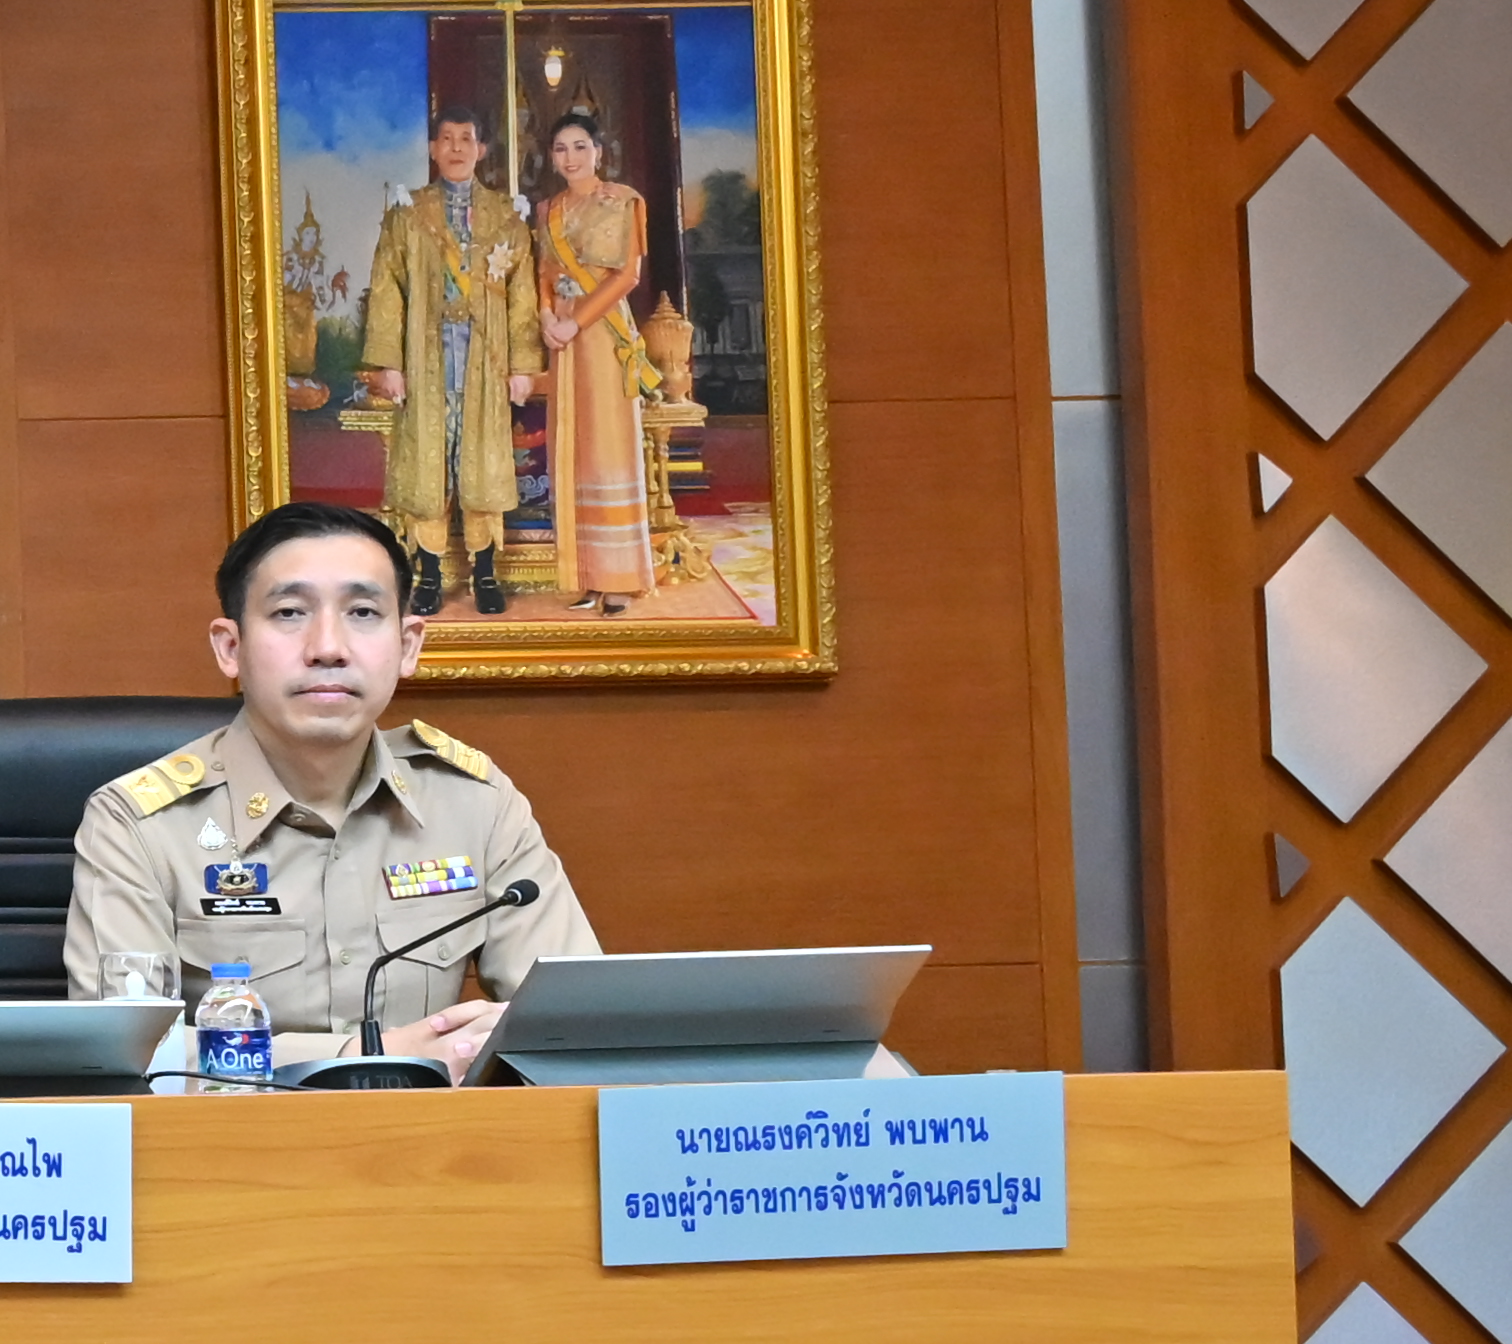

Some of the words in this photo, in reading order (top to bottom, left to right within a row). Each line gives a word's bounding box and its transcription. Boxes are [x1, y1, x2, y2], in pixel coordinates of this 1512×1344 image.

[206, 1048, 218, 1069] A
[221, 1047, 264, 1070] One
[376, 1074, 413, 1088] TOA
[675, 1108, 871, 1155] นายณรงค์วิทย์
[884, 1115, 989, 1146] พบพาน
[625, 1169, 1041, 1233] รองผู้ว่าราชการจังหวัดนครปฐม
